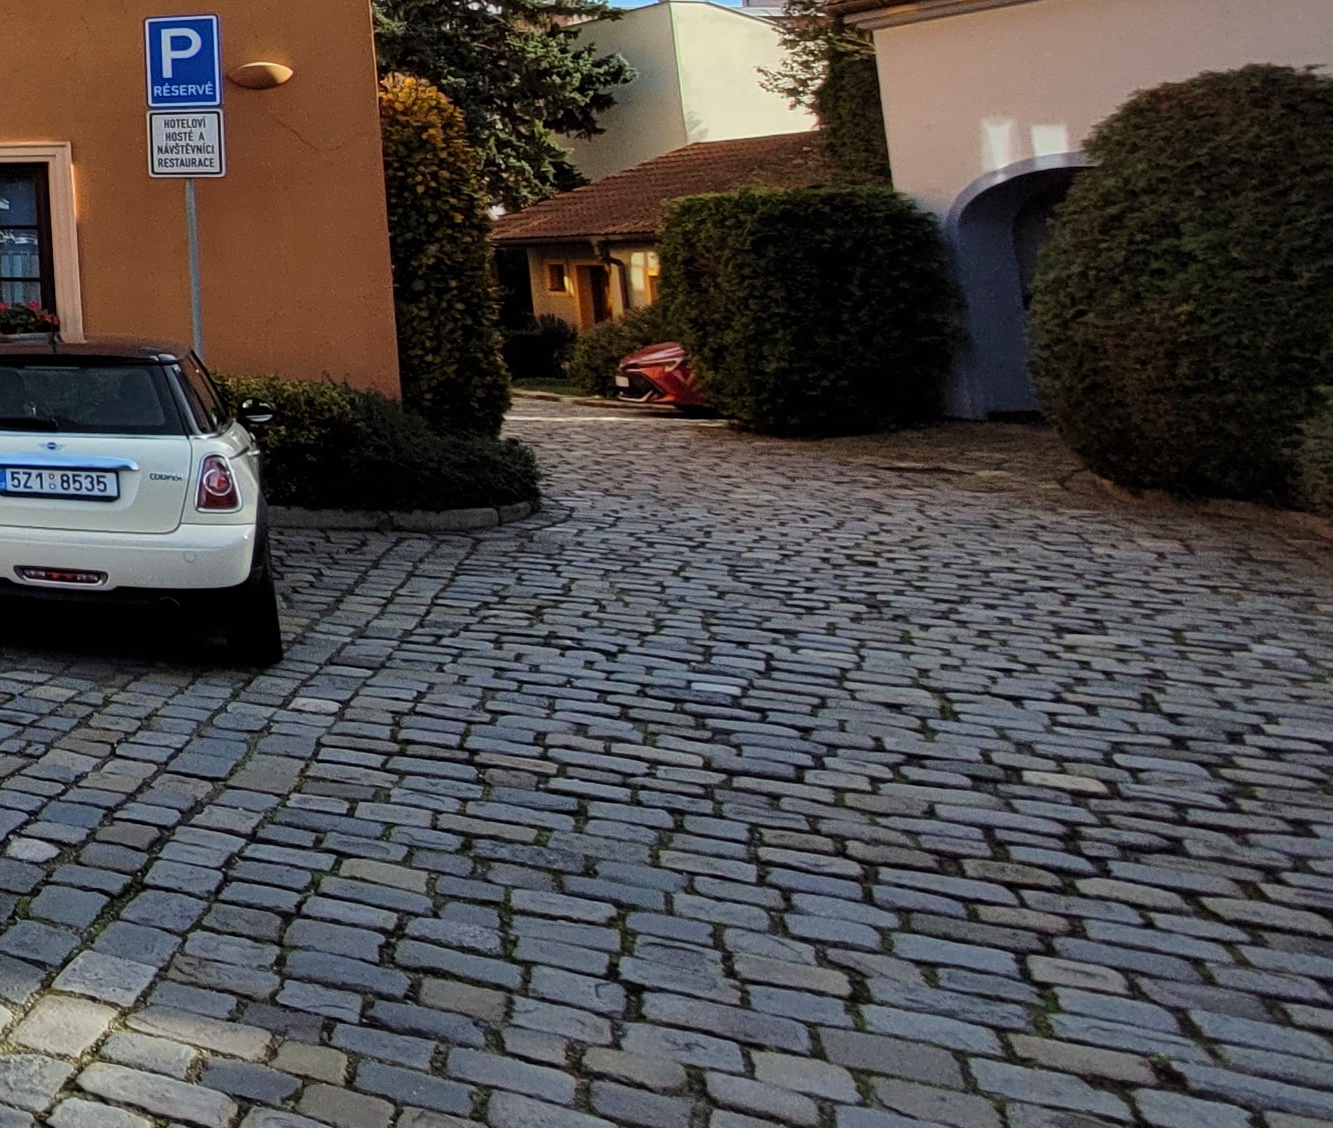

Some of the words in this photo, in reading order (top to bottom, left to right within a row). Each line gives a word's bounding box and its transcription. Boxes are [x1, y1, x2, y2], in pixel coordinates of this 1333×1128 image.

[161, 28, 202, 78] P
[153, 81, 214, 97] RÉSERVÉ
[163, 116, 206, 129] HOTELOVÍ
[165, 129, 194, 142] HOSTÉ
[198, 132, 205, 141] A
[157, 142, 215, 155] NÁVŠTĚVNÍCI
[157, 157, 215, 169] RESTAURACE
[10, 471, 44, 490] 5Z1
[60, 473, 108, 493] 8535
